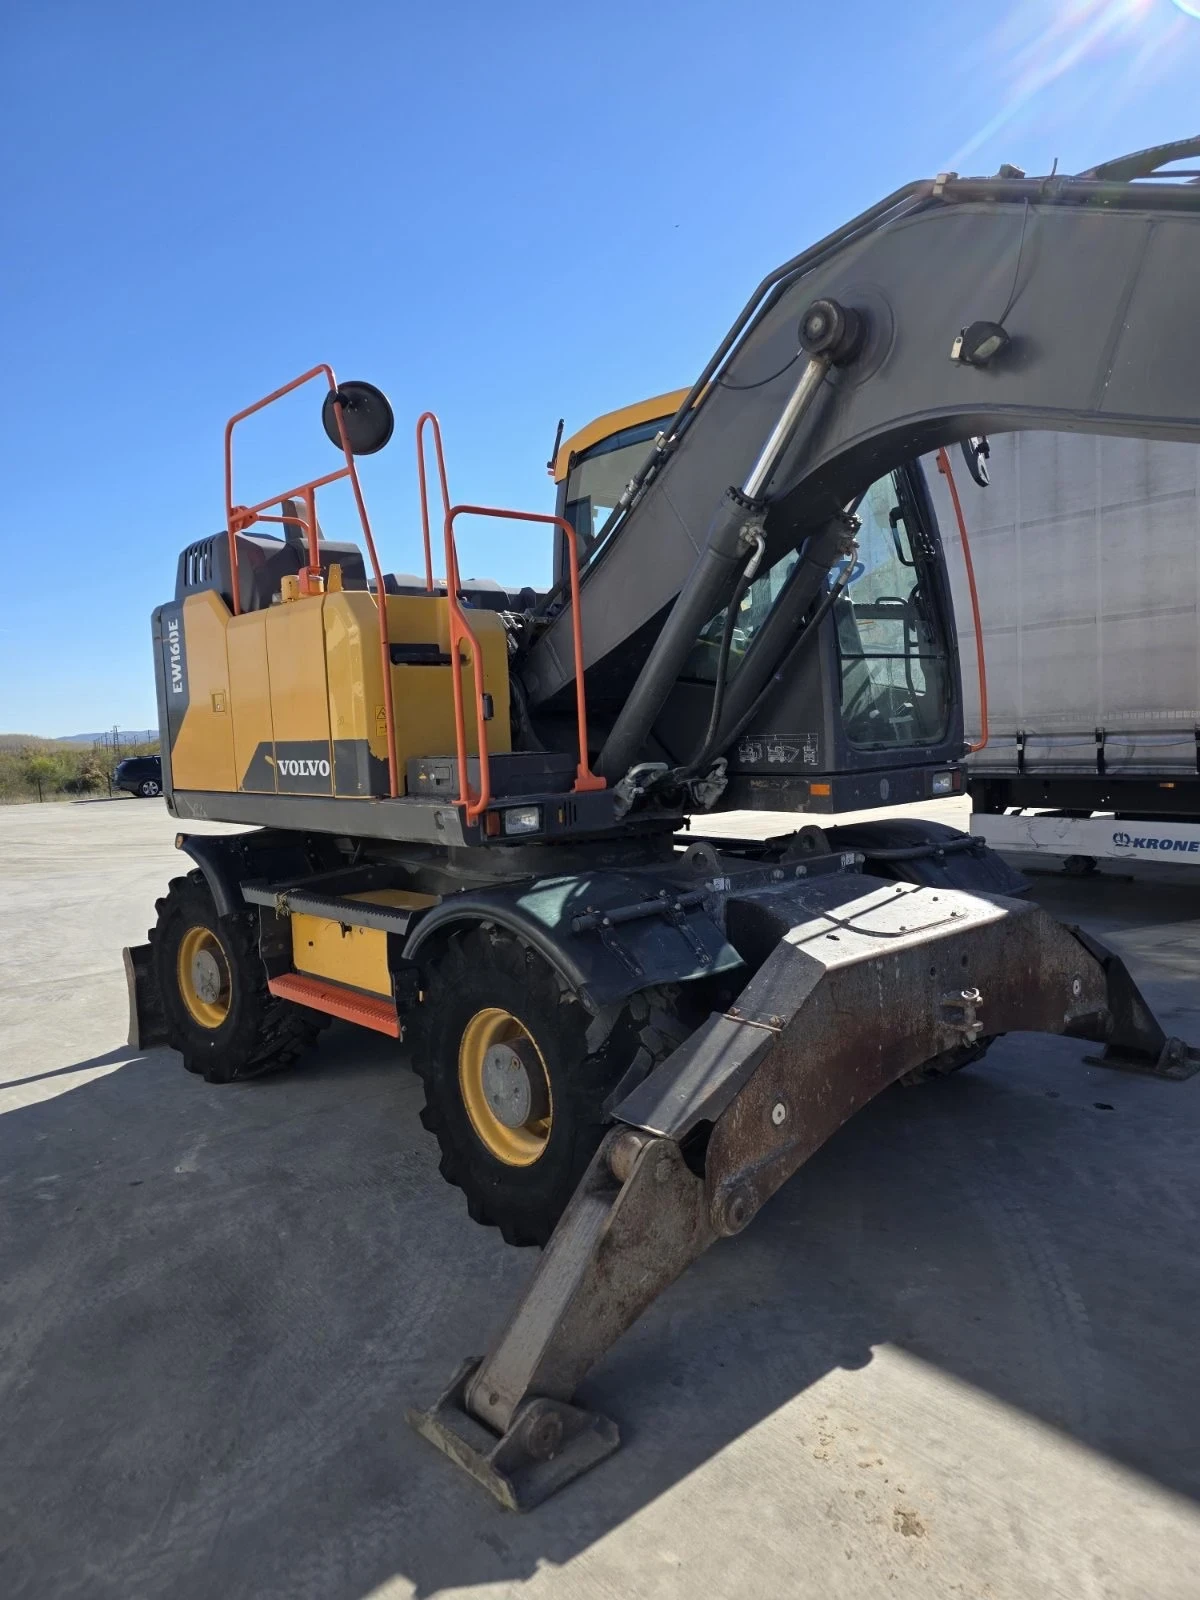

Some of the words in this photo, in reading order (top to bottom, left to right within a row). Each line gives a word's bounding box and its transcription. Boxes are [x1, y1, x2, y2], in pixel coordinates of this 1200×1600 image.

[168, 619, 183, 693] EW160E
[277, 760, 330, 776] VOLVO
[1133, 838, 1200, 852] KRONE
